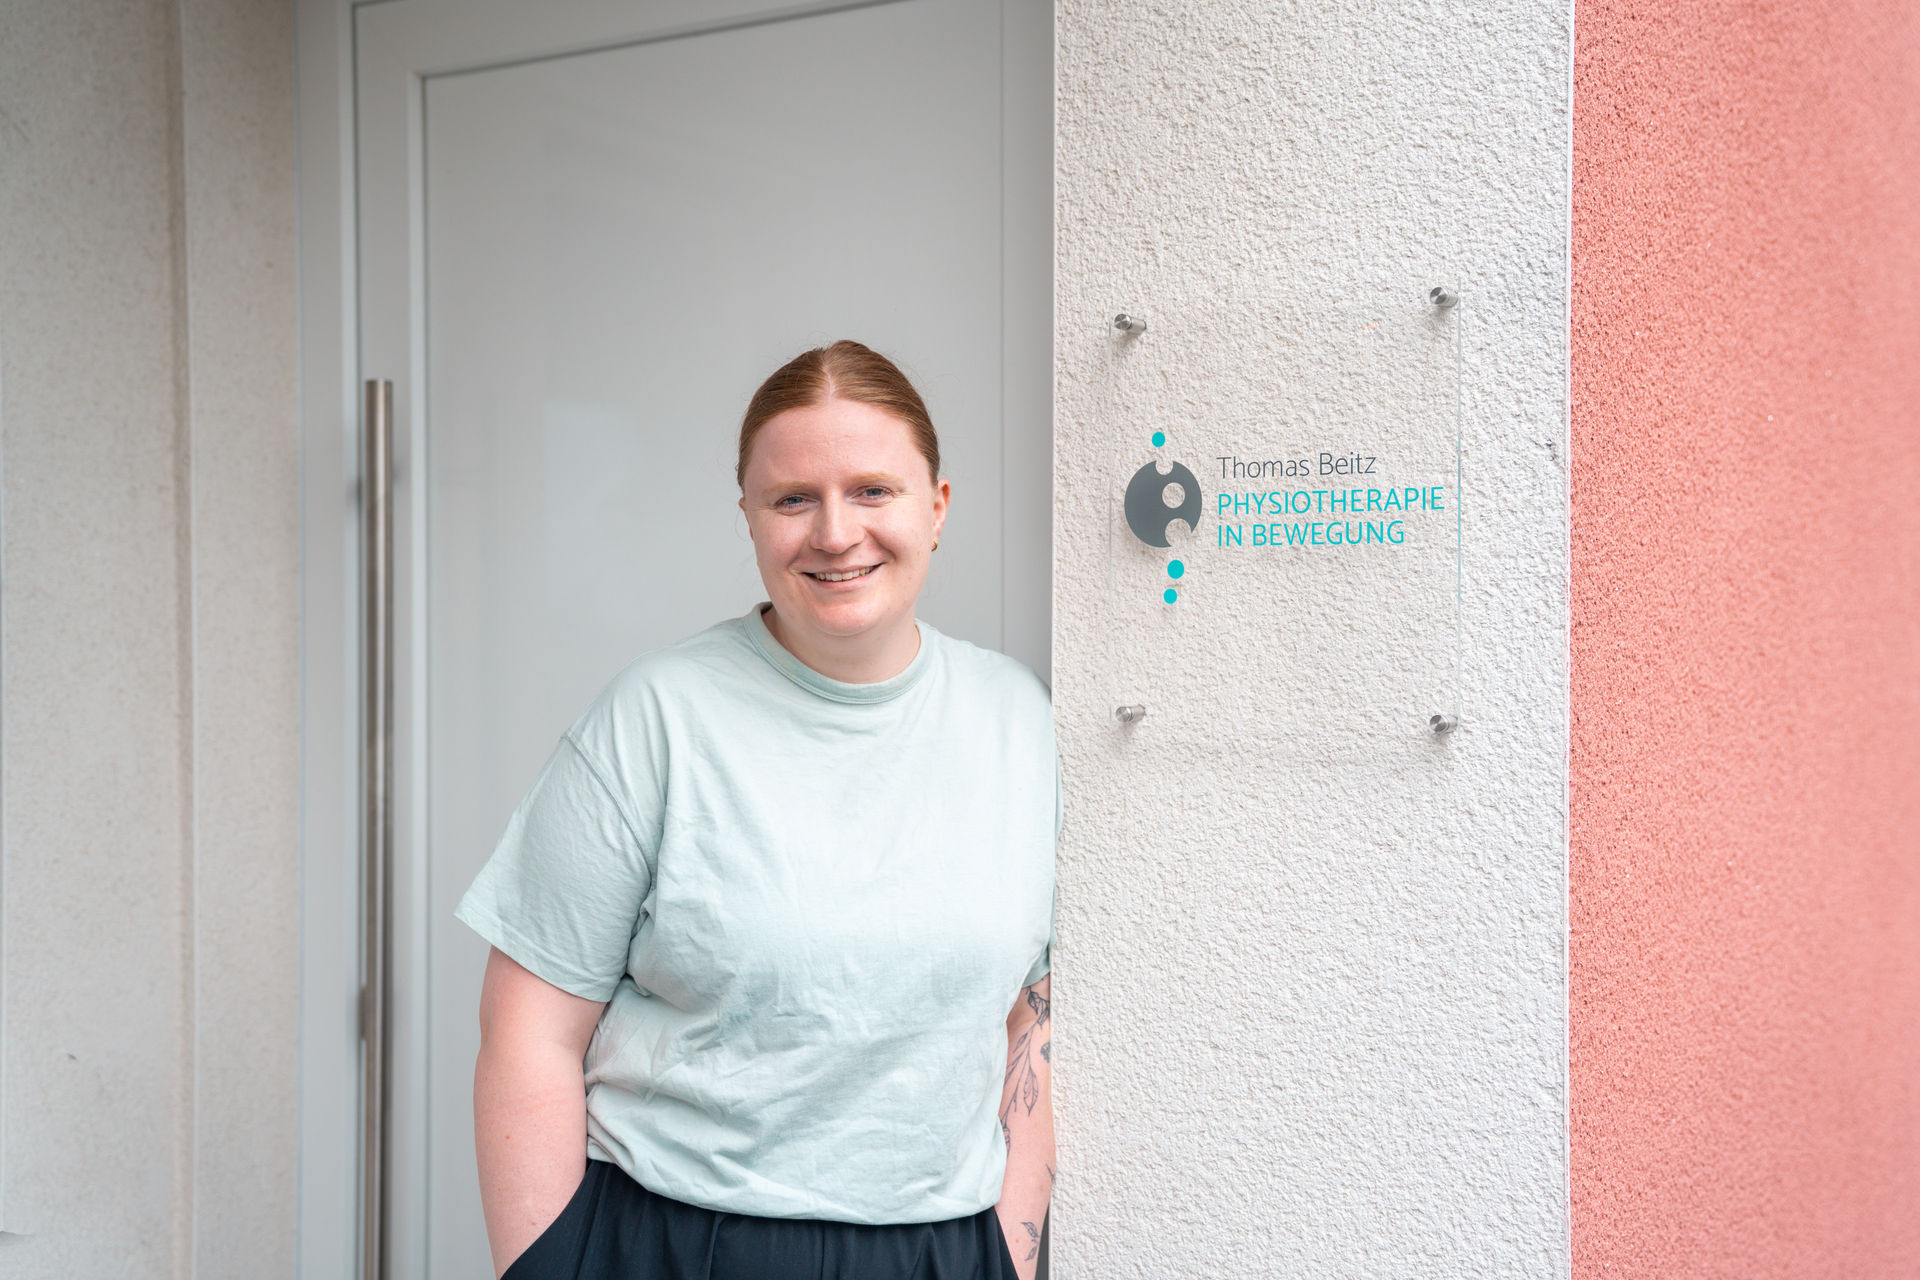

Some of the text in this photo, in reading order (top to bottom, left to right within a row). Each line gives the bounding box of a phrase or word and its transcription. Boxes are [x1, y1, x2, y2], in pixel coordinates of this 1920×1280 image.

[1216, 452, 1377, 479] Thomas Beitz
[1218, 486, 1445, 516] PHYSIOTHERAPIE
[1218, 520, 1405, 547] IN BEWEGUNG
